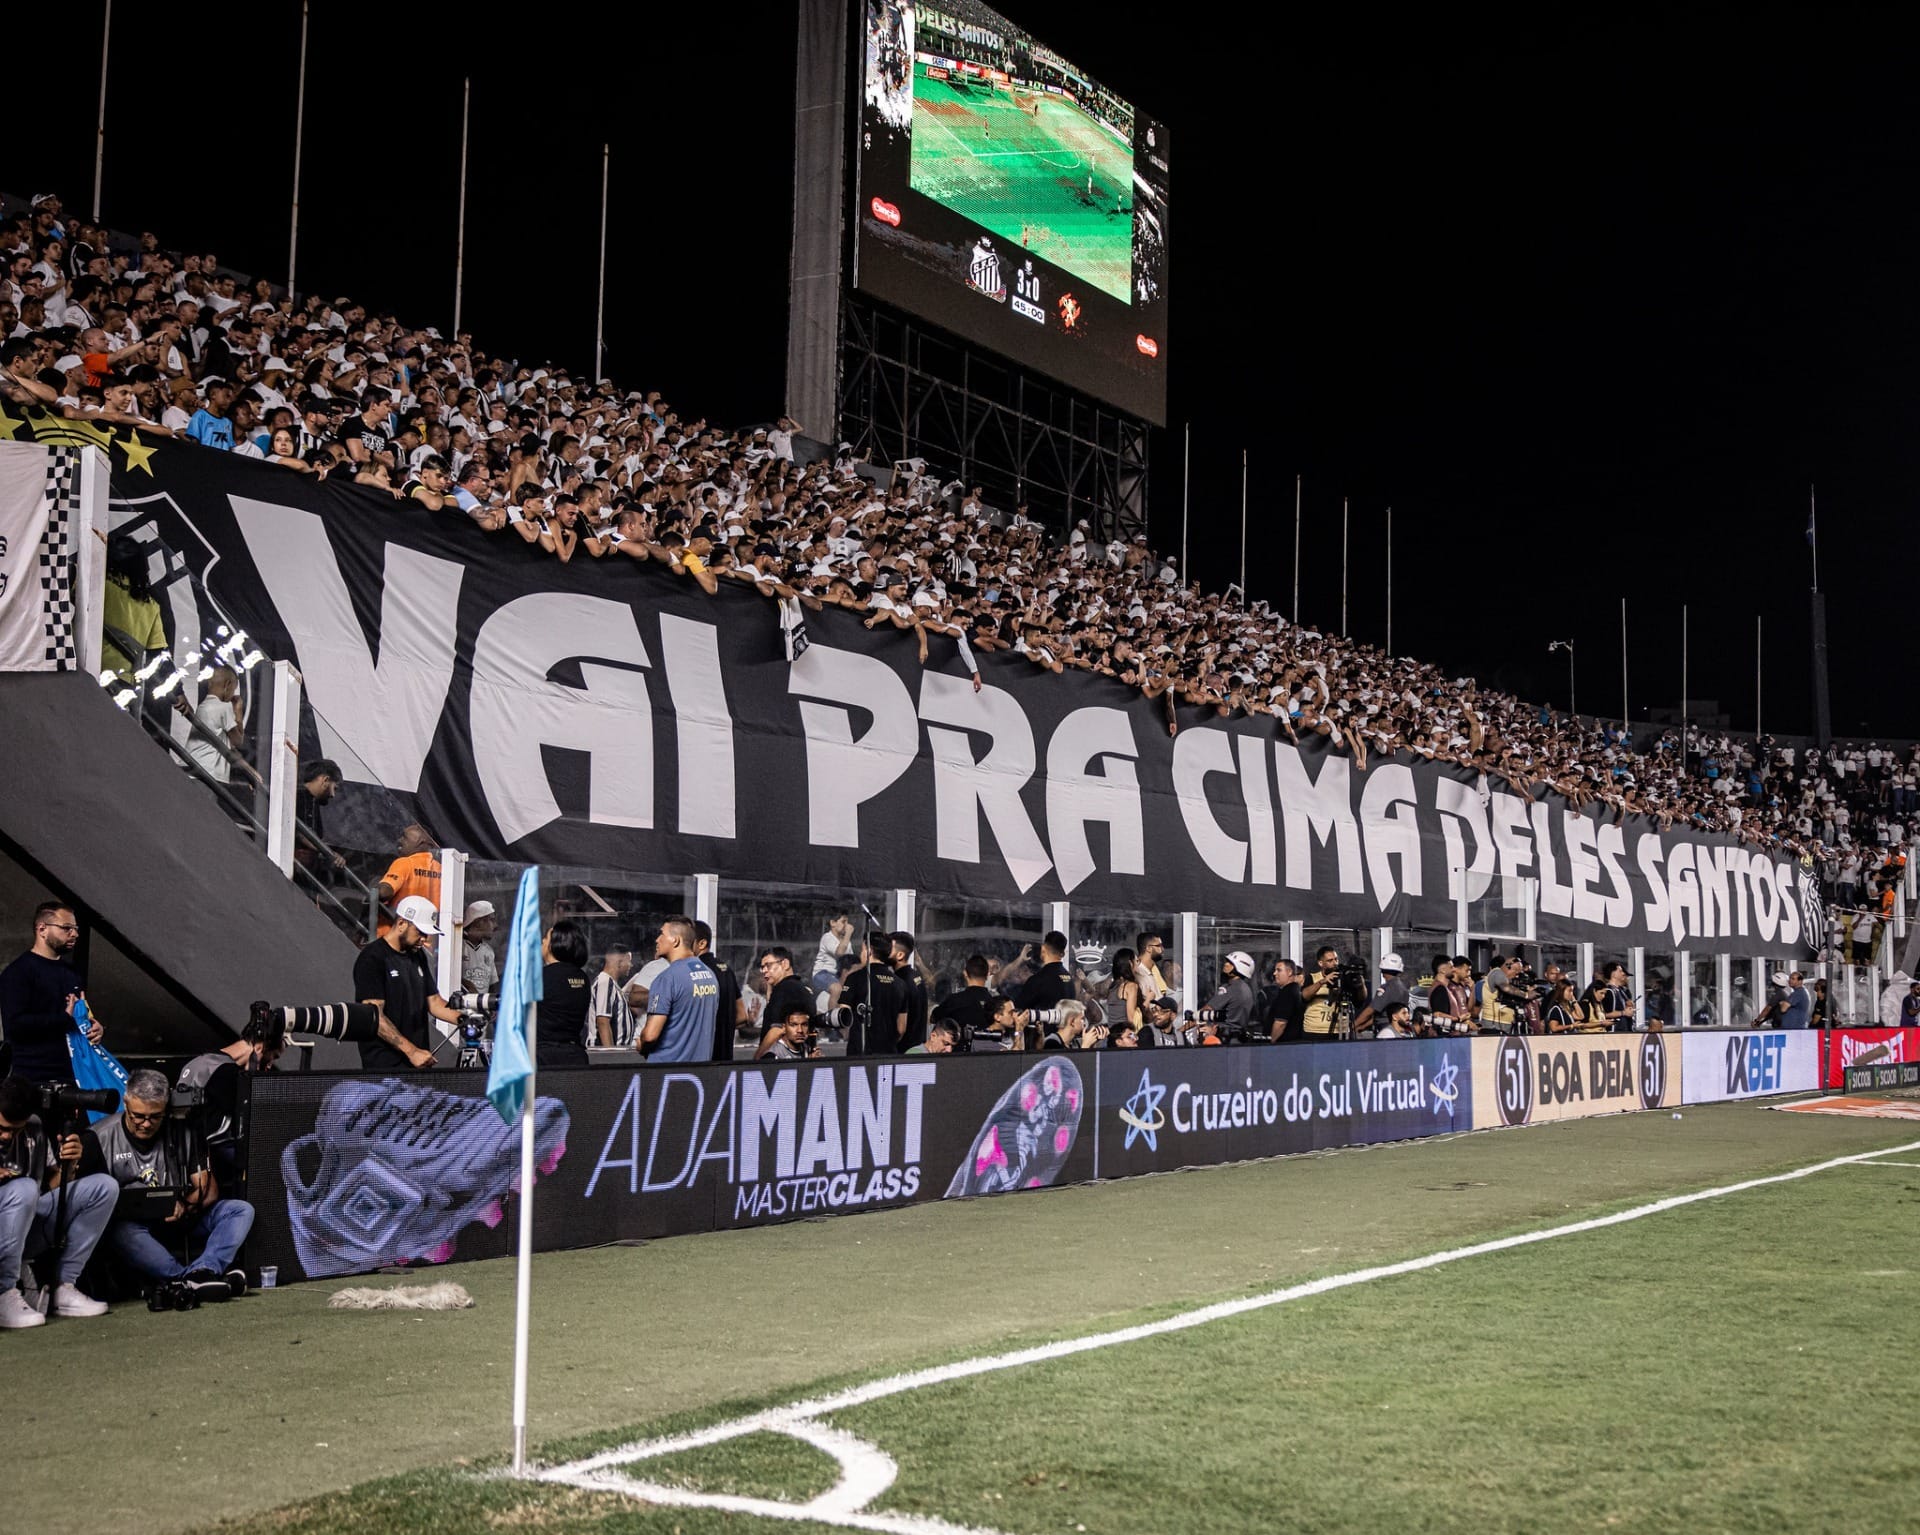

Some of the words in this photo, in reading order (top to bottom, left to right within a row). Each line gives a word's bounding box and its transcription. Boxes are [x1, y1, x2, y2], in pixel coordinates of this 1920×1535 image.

[1014, 300, 1043, 320] 45:00
[227, 494, 736, 844] VAI
[788, 642, 1145, 895] PRA
[1172, 726, 1423, 912] CIMA
[1436, 776, 1633, 928] DELES
[1637, 832, 1801, 947] SANTOS
[1505, 1048, 1525, 1111] 51
[1538, 1051, 1585, 1105] BOA
[1589, 1049, 1634, 1100] IDEIA
[1645, 1044, 1660, 1097] 51
[1726, 1034, 1786, 1094] 1XBET
[585, 1062, 936, 1198] ADAMANT
[1171, 1077, 1278, 1133] Cruzeiro
[1283, 1073, 1311, 1122] do
[1318, 1069, 1352, 1118] Sul
[1356, 1064, 1426, 1114] Virtual
[734, 1165, 921, 1220] MASTERCLASS
